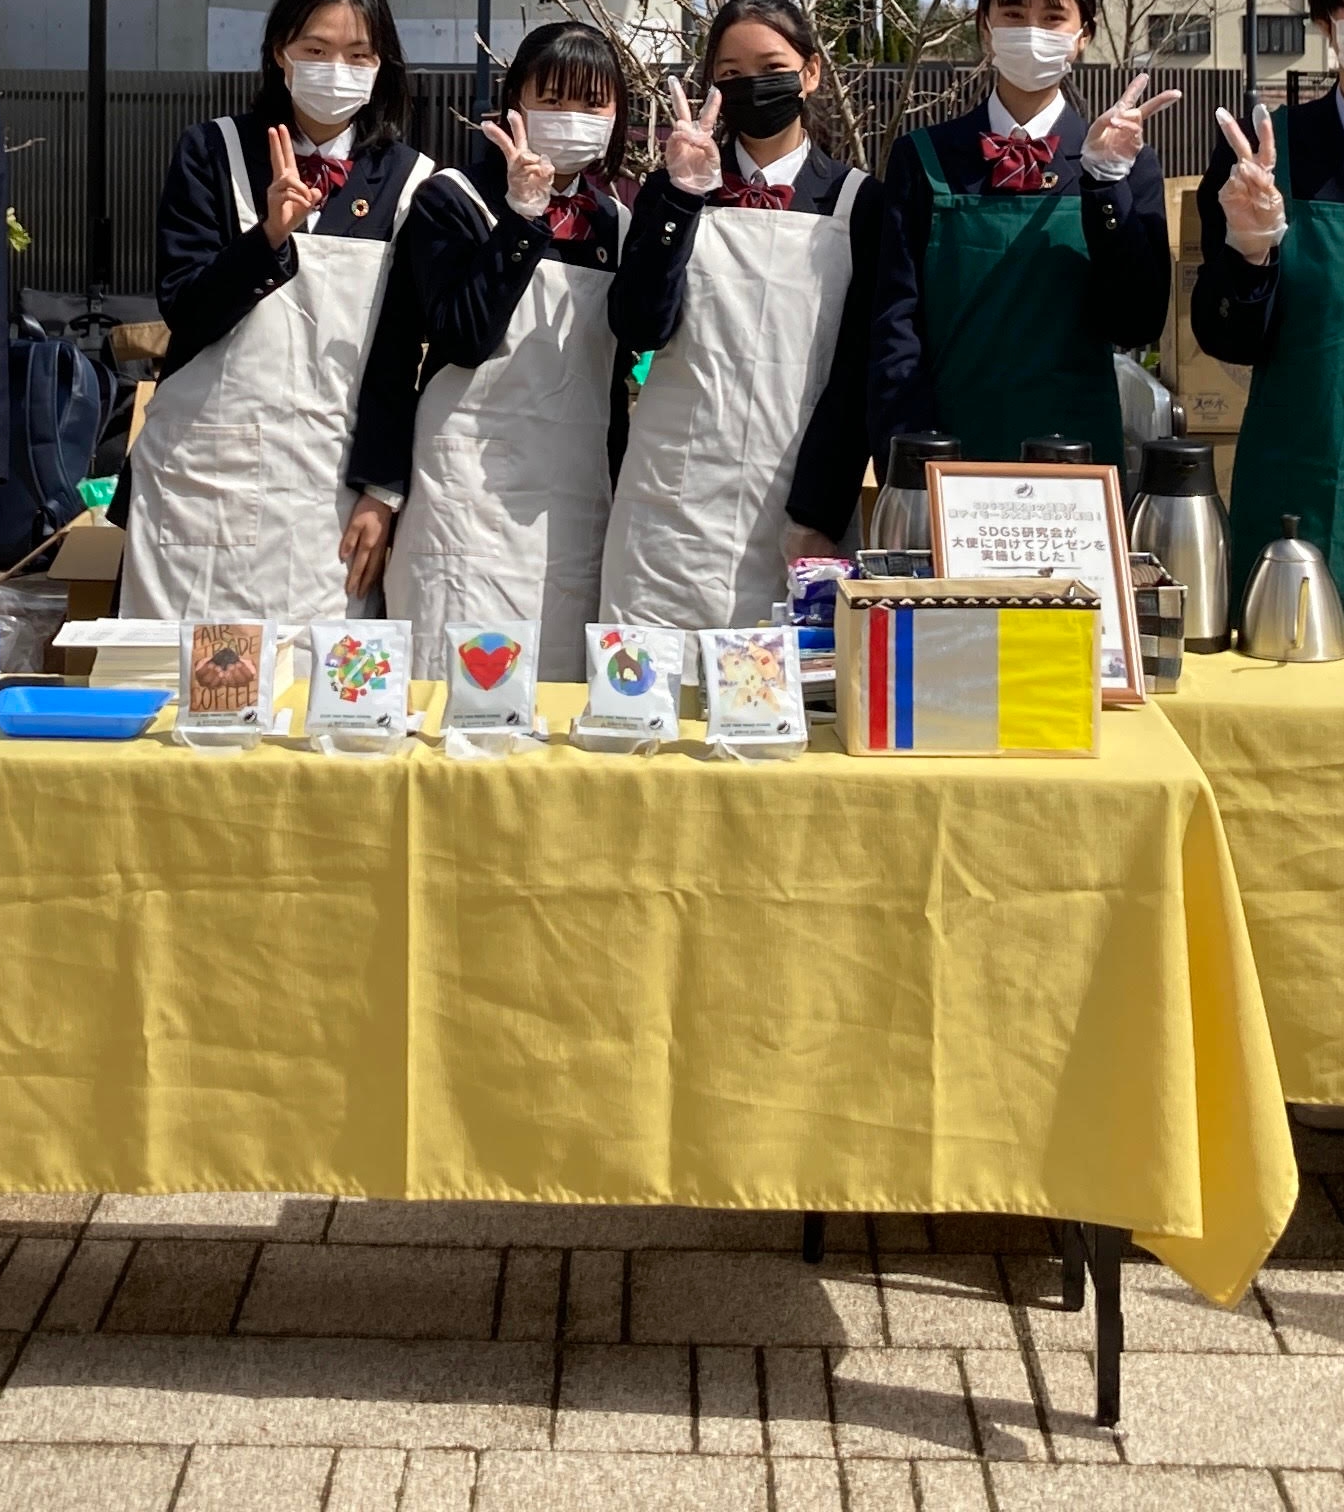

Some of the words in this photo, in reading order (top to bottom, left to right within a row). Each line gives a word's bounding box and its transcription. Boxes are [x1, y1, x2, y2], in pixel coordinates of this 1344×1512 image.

[978, 526, 1077, 539] SDGS研究会が
[193, 624, 234, 649] FAIR
[190, 686, 258, 712] COFFEE
